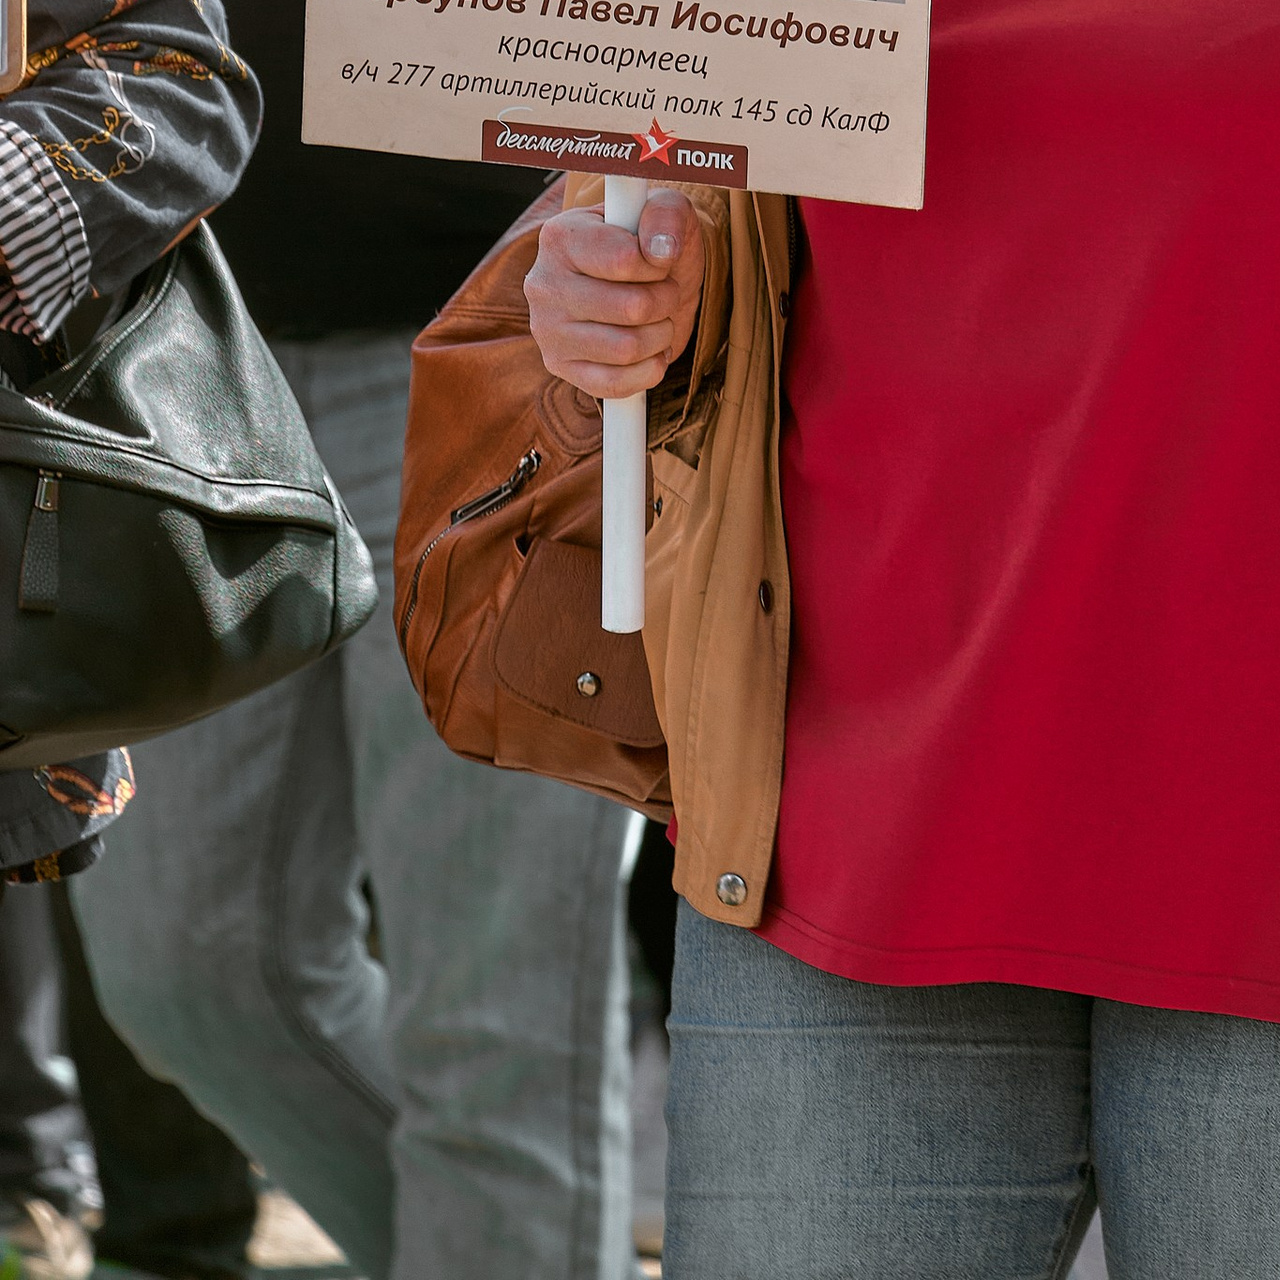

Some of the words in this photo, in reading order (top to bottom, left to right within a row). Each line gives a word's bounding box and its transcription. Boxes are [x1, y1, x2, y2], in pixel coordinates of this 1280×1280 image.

[670, 0, 900, 53] Иосифович
[497, 34, 709, 79] красноармеец
[341, 59, 379, 86] в/ч
[388, 61, 436, 88] 277
[440, 70, 656, 111] артиллерийский
[663, 93, 724, 118] полк
[730, 96, 778, 123] 145
[785, 103, 813, 126] сд
[820, 105, 891, 135] КалФ
[676, 148, 735, 171] ПОЛК
